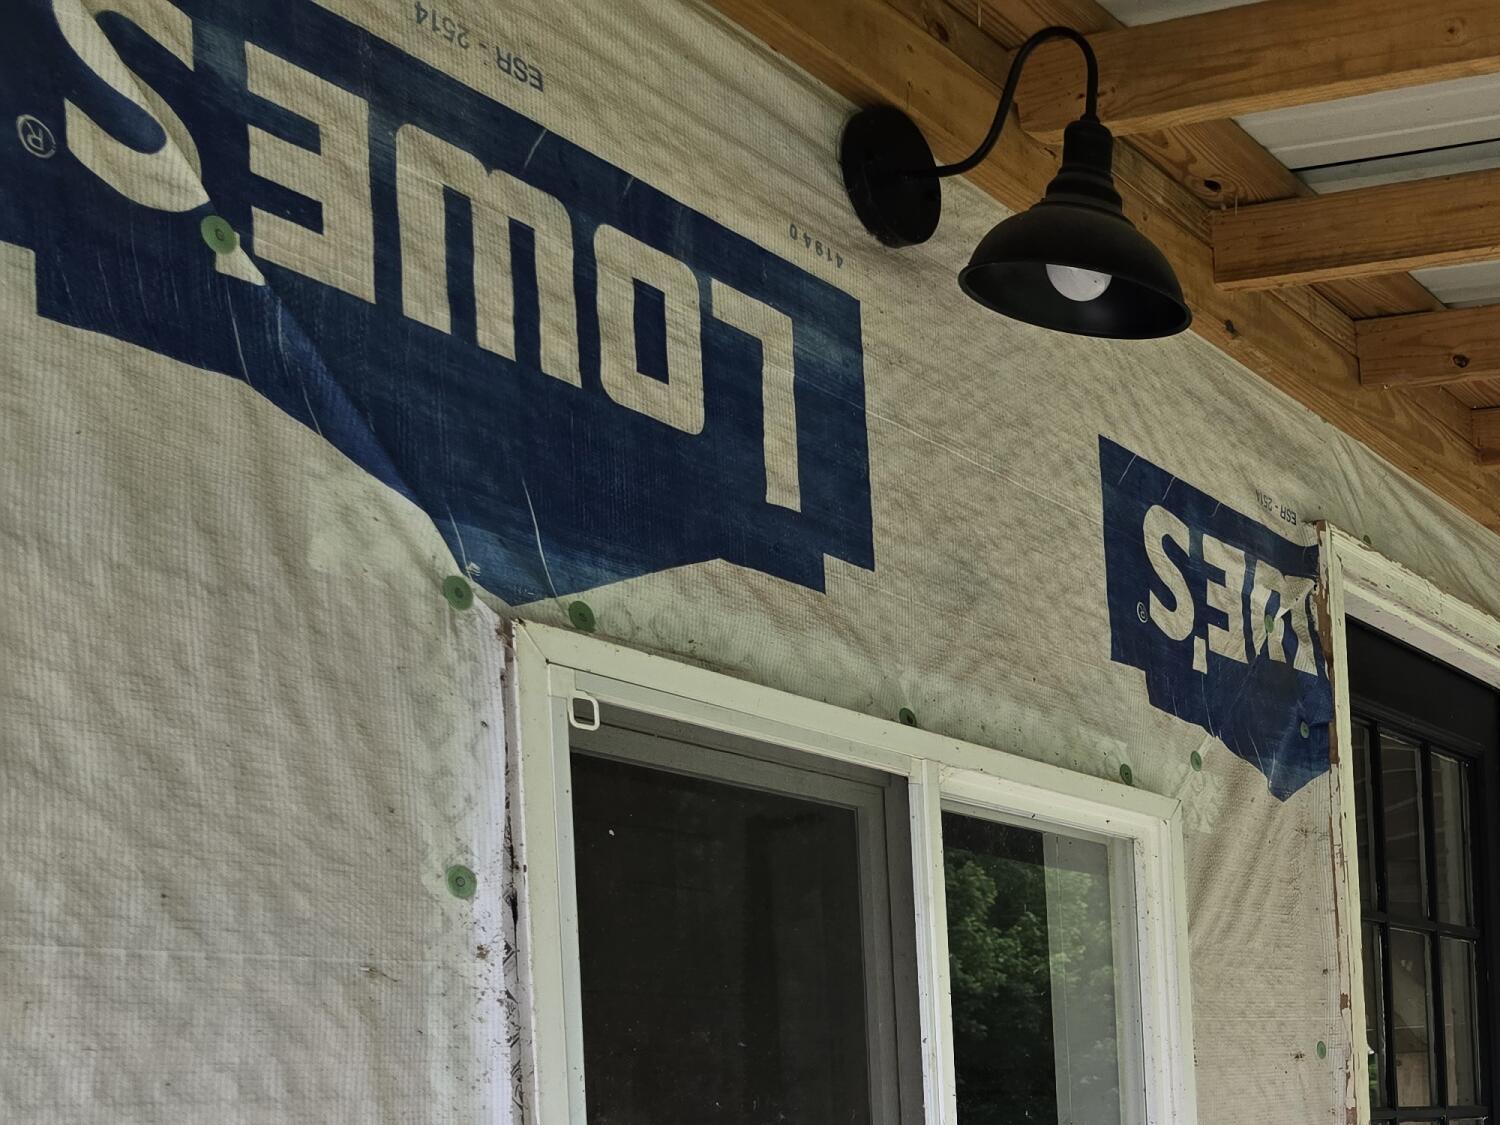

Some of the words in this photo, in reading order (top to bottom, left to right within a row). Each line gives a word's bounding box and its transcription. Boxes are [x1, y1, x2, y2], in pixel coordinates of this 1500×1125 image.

[415, 1, 470, 49] 2514
[495, 46, 543, 92] ESR
[789, 223, 843, 269] 41940
[1280, 503, 1297, 526] ESR
